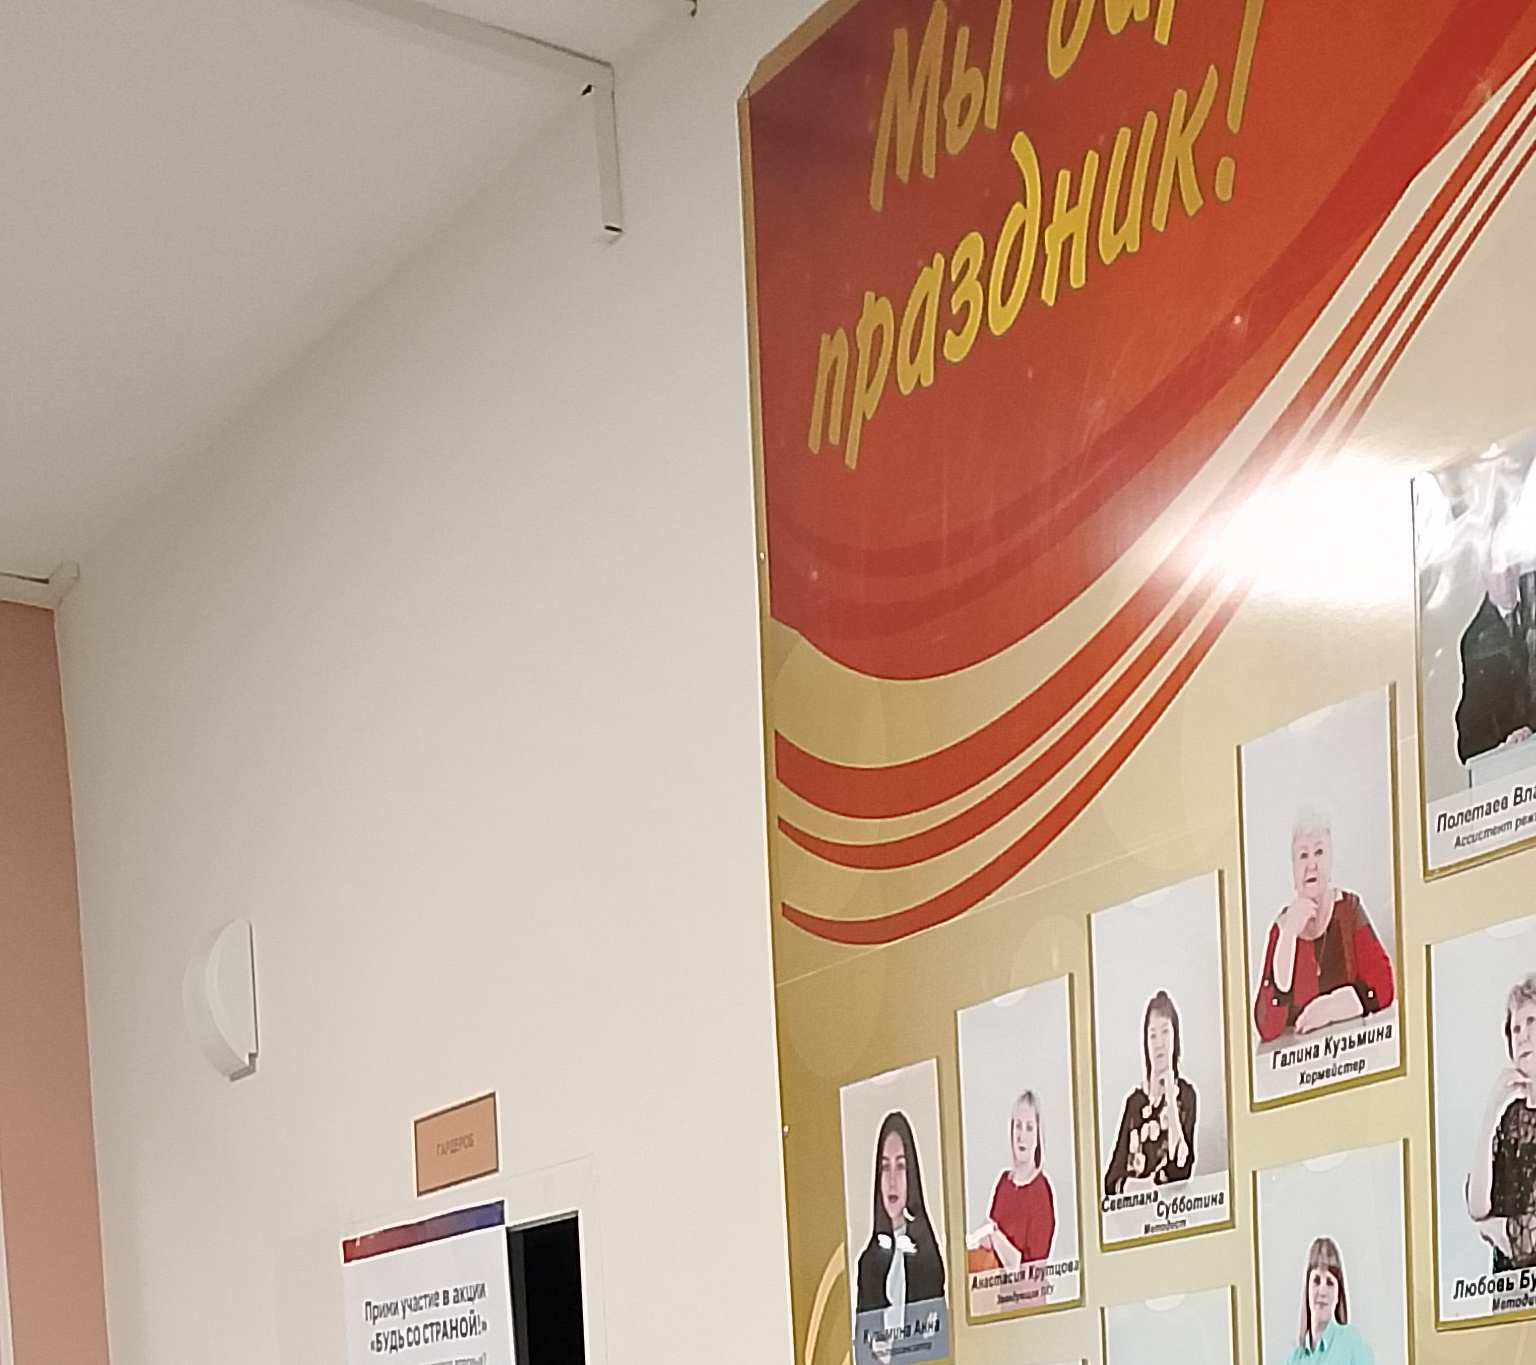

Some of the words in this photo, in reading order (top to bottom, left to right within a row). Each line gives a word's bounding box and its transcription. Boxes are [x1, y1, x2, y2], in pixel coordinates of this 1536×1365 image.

[869, 0, 1011, 212] Мы
[808, 0, 1265, 470] праздник!
[1437, 796, 1508, 833] Полетаев
[1455, 821, 1512, 849] Ассистент
[1273, 1043, 1319, 1069] Галина
[1324, 1025, 1392, 1059] Кузьмина
[1299, 1059, 1365, 1085] Хормейстер
[437, 1133, 474, 1156] ГАРДЕРОБ
[1102, 1190, 1158, 1212] Светлана
[1157, 1192, 1224, 1219] Субботина
[972, 1270, 1025, 1290] Анастасия
[1453, 1276, 1515, 1299] Любовь
[365, 1300, 399, 1325] Прими
[401, 1291, 440, 1320] участие
[443, 1290, 449, 1306] в
[453, 1283, 486, 1304] акции
[370, 1328, 404, 1354] «БУДЬ
[406, 1325, 420, 1347] СО
[423, 1309, 487, 1344] СТРАНОЙ!»
